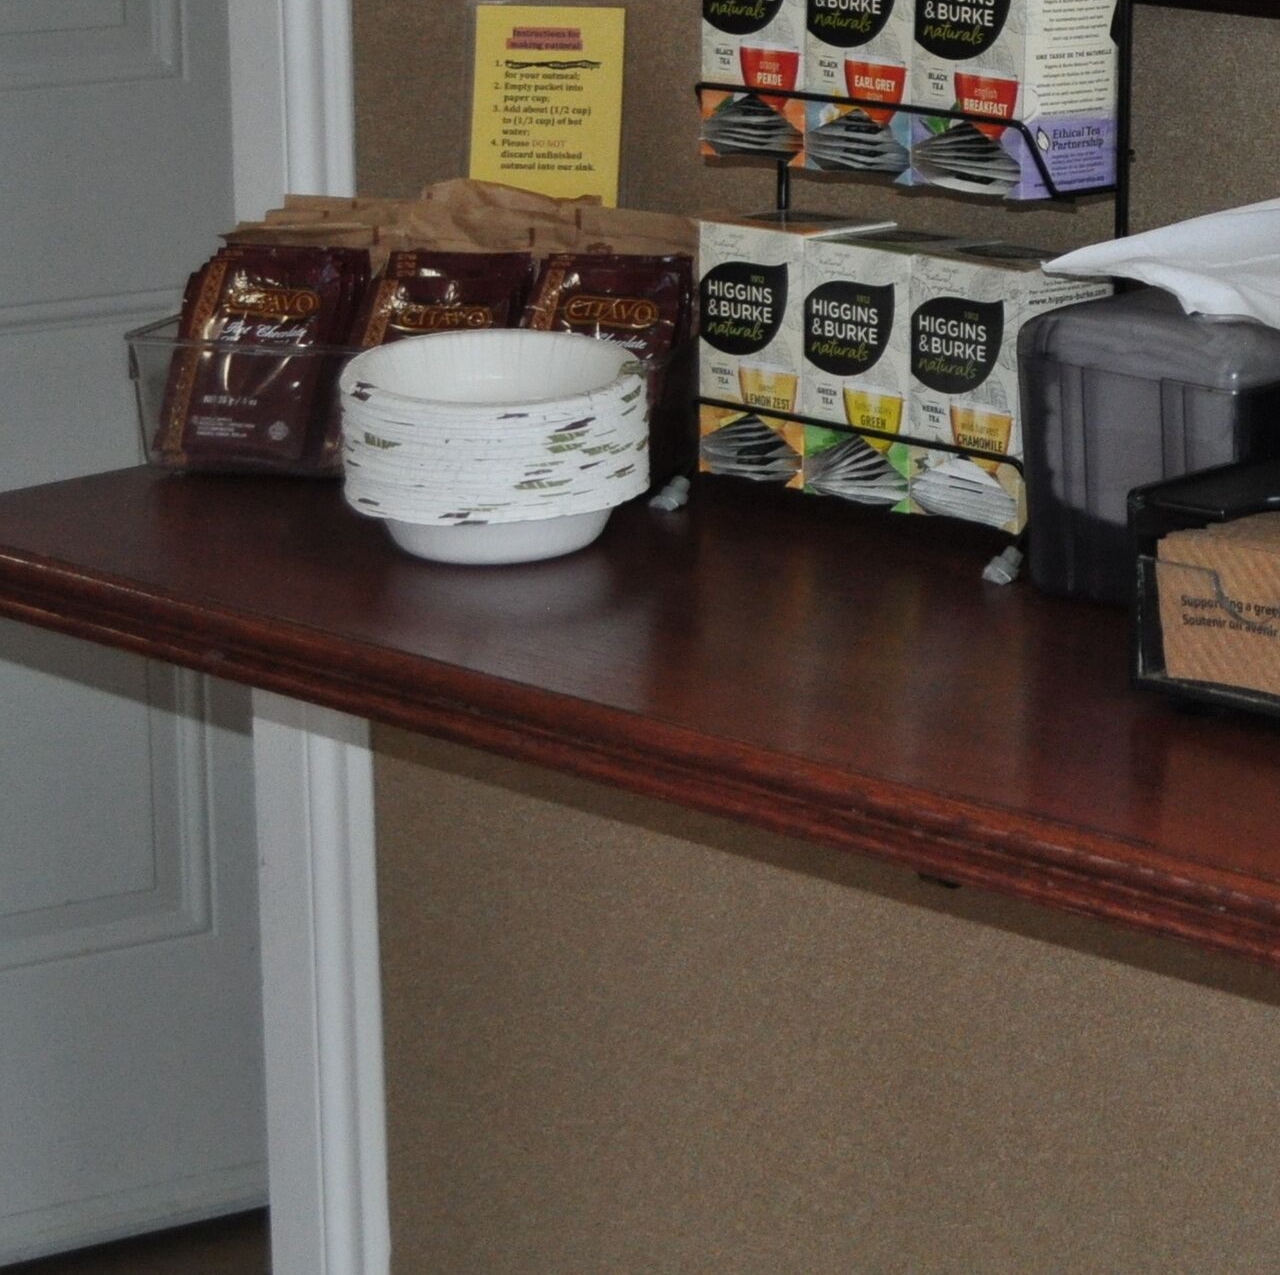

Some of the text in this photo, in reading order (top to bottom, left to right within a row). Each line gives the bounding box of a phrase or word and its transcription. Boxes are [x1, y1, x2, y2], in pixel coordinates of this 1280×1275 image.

[814, 10, 872, 32] naturals
[923, 23, 985, 45] naturals
[715, 47, 734, 57] BLACK
[719, 57, 730, 66] TEA
[819, 59, 838, 69] BLACK
[504, 71, 516, 79] for
[518, 72, 540, 81] your
[823, 69, 834, 78] TEA
[928, 73, 947, 83] BLACK
[504, 83, 531, 92] Empty
[534, 83, 563, 93] packet
[565, 83, 584, 92] into
[854, 75, 896, 92] EARL GREY
[932, 82, 944, 91] TEA
[504, 95, 529, 104] paper
[974, 87, 998, 102] english
[503, 105, 521, 113] Add
[522, 105, 548, 114] about
[550, 105, 570, 115] (1/2
[571, 106, 591, 116] cup)
[963, 97, 1008, 117] BREAKFAST
[502, 117, 582, 127] to (1/3 cup) of hot
[1052, 126, 1101, 139] Ethical Tea
[502, 139, 529, 147] Please
[532, 139, 545, 147] DO
[547, 140, 567, 148] NOT
[1051, 136, 1104, 151] Partnership
[501, 150, 582, 159] discard unfinished
[500, 162, 535, 170] oatmeal
[537, 162, 555, 170] into
[557, 163, 572, 171] our
[708, 279, 773, 304] HIGGINS
[812, 298, 878, 325] HIGGINS
[707, 320, 765, 342] naturals
[919, 314, 987, 342] HIGGINS
[811, 339, 869, 362] naturals
[711, 367, 734, 377] HERBAL
[918, 356, 978, 380] naturals
[718, 376, 729, 385] TEA
[817, 387, 837, 397] GREEN
[745, 393, 790, 411] LEMON ZEST
[822, 397, 834, 406] TEA
[922, 404, 946, 415] HERBAL
[860, 414, 886, 430] GREEN
[928, 414, 940, 424] TEA
[957, 433, 1003, 453] CHAMOMILE
[1245, 603, 1252, 613] a
[1182, 613, 1227, 631] Soutenir
[1245, 621, 1278, 639] avenir
